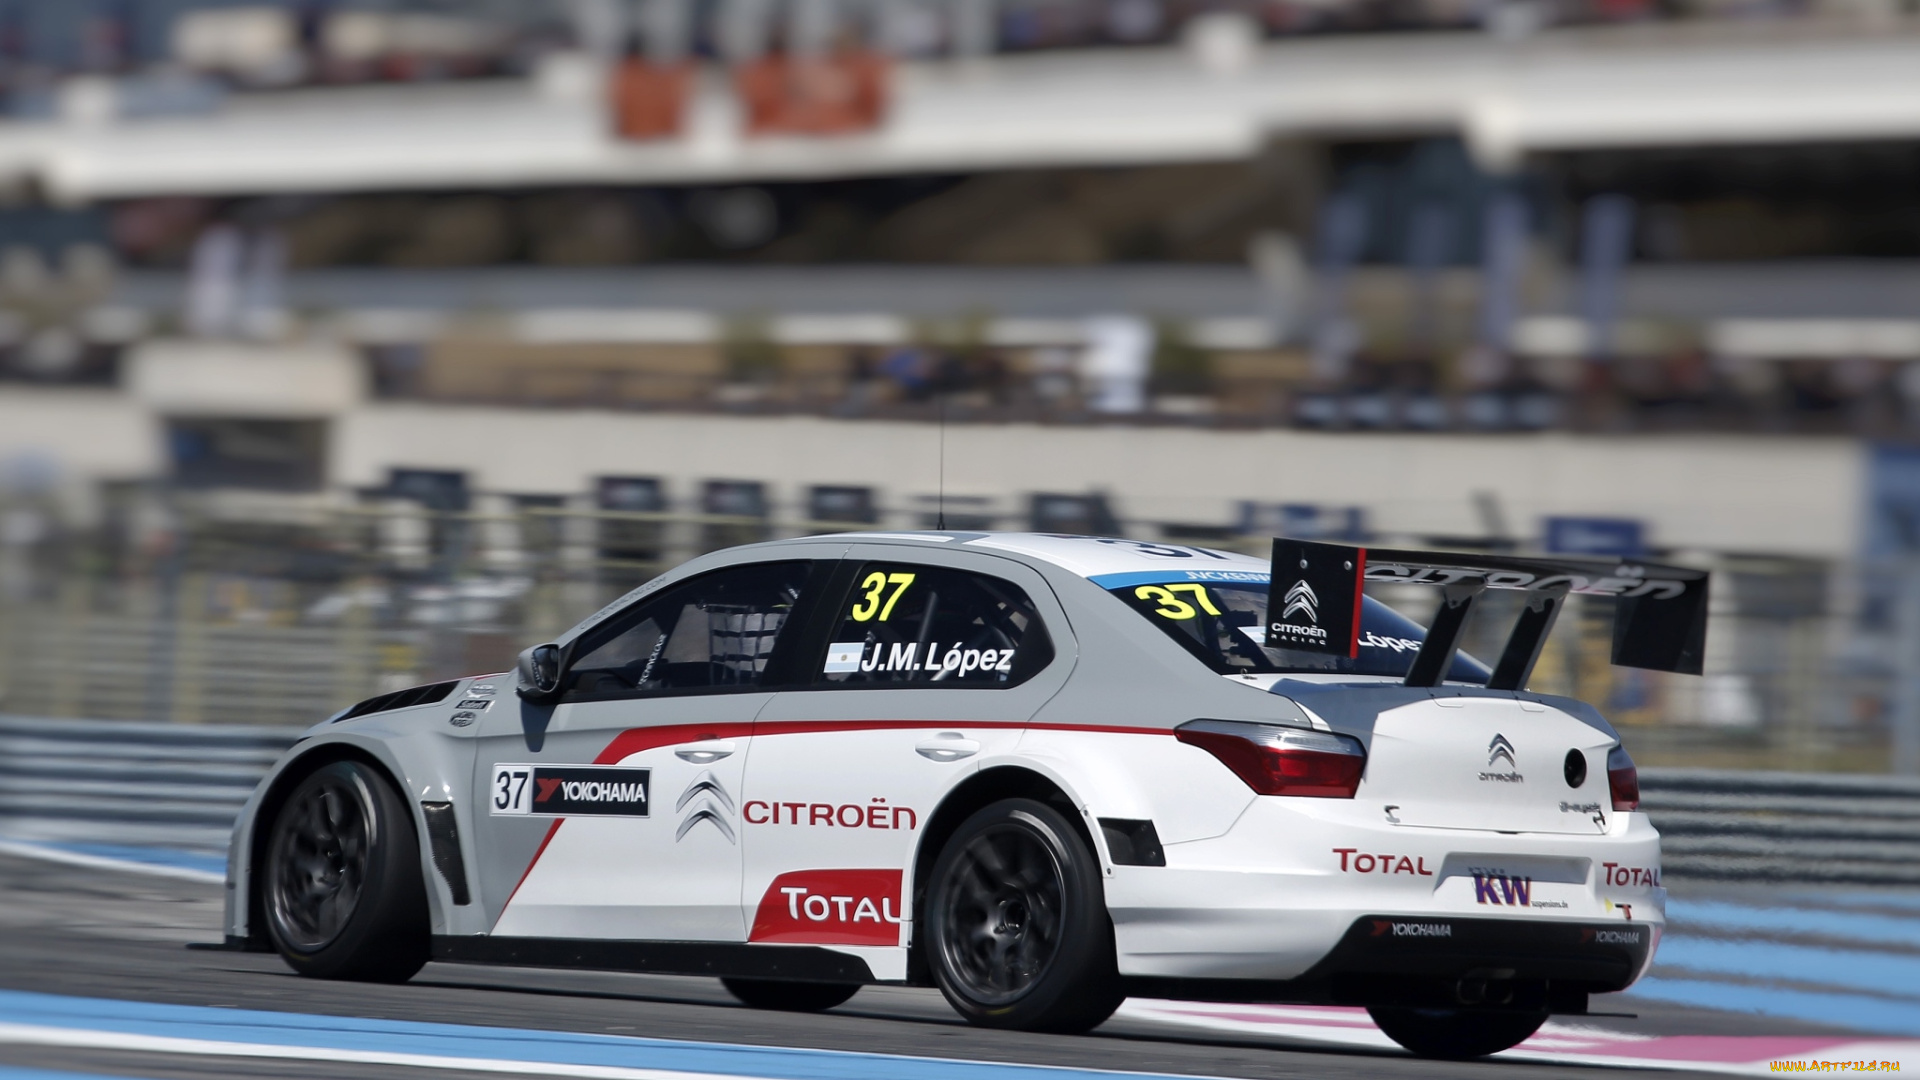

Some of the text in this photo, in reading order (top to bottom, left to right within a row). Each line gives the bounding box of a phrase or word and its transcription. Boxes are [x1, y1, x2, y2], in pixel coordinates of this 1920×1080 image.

[852, 571, 916, 622] 37
[1134, 583, 1222, 620] 37
[1271, 623, 1327, 638] CITROËN
[862, 642, 1015, 677] J.M. López
[494, 771, 646, 809] 37 YOKOHAMA
[743, 797, 917, 831] CITROËN
[1332, 848, 1432, 876] TOTAL
[1603, 862, 1660, 887] TOTAL
[780, 887, 900, 924] TOTAL
[1473, 873, 1531, 907] KW
[1392, 923, 1640, 943] YOKOHAMA YOKOHAMA
